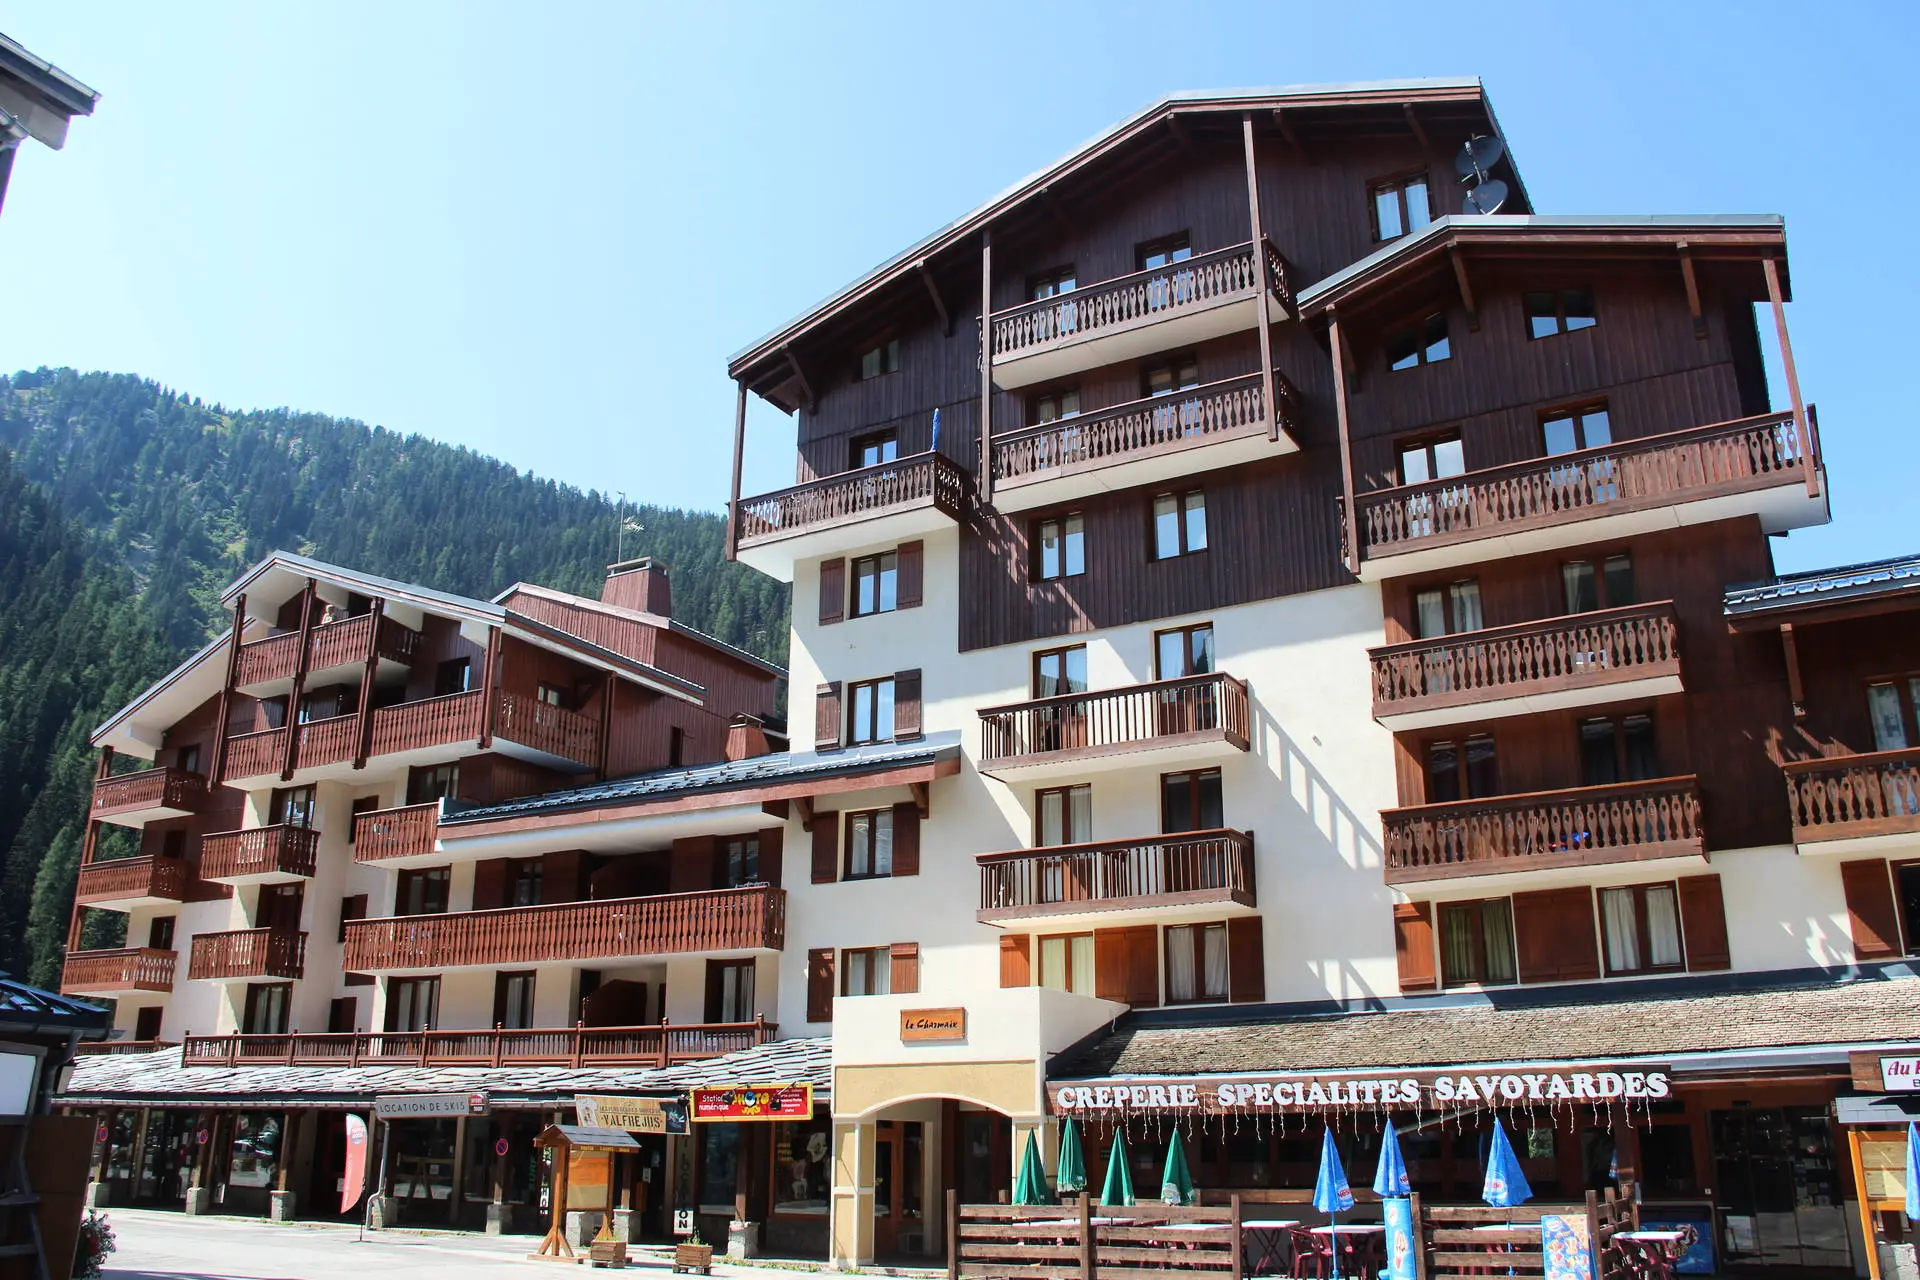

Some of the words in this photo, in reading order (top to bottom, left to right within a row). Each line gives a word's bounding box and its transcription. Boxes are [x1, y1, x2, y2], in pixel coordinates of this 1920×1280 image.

[1887, 1061, 1910, 1075] Au
[1057, 1084, 1198, 1108] CREPERIE
[1217, 1078, 1420, 1106] SPECIALITES
[1435, 1073, 1669, 1100] SAVOYARDES
[380, 1103, 426, 1112] LOCATION
[429, 1103, 441, 1111] DE
[445, 1102, 466, 1110] SKIS
[603, 1113, 661, 1129] VALFREJUS
